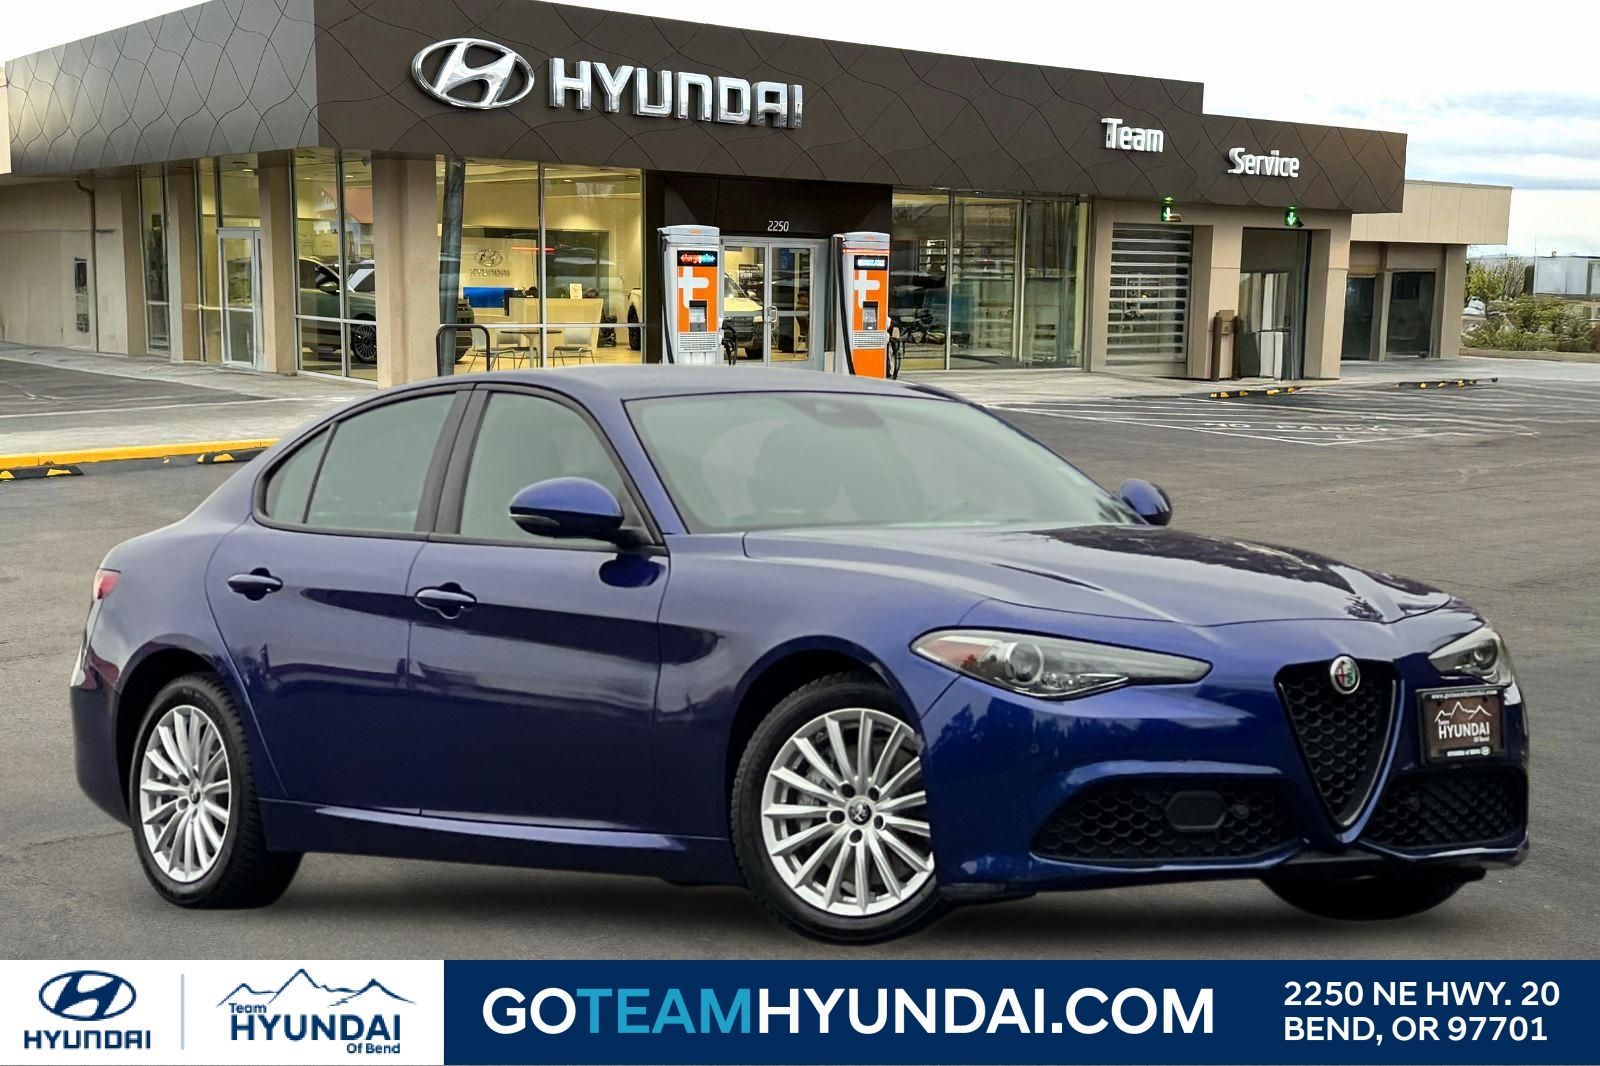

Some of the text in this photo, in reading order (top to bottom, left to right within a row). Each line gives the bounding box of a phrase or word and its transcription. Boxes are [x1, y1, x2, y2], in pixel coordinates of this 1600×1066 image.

[548, 57, 804, 129] HYUNDAI
[1101, 117, 1164, 153] Team
[1227, 147, 1300, 178] Service
[767, 220, 790, 232] 2250
[1438, 721, 1490, 740] HYUNDAI
